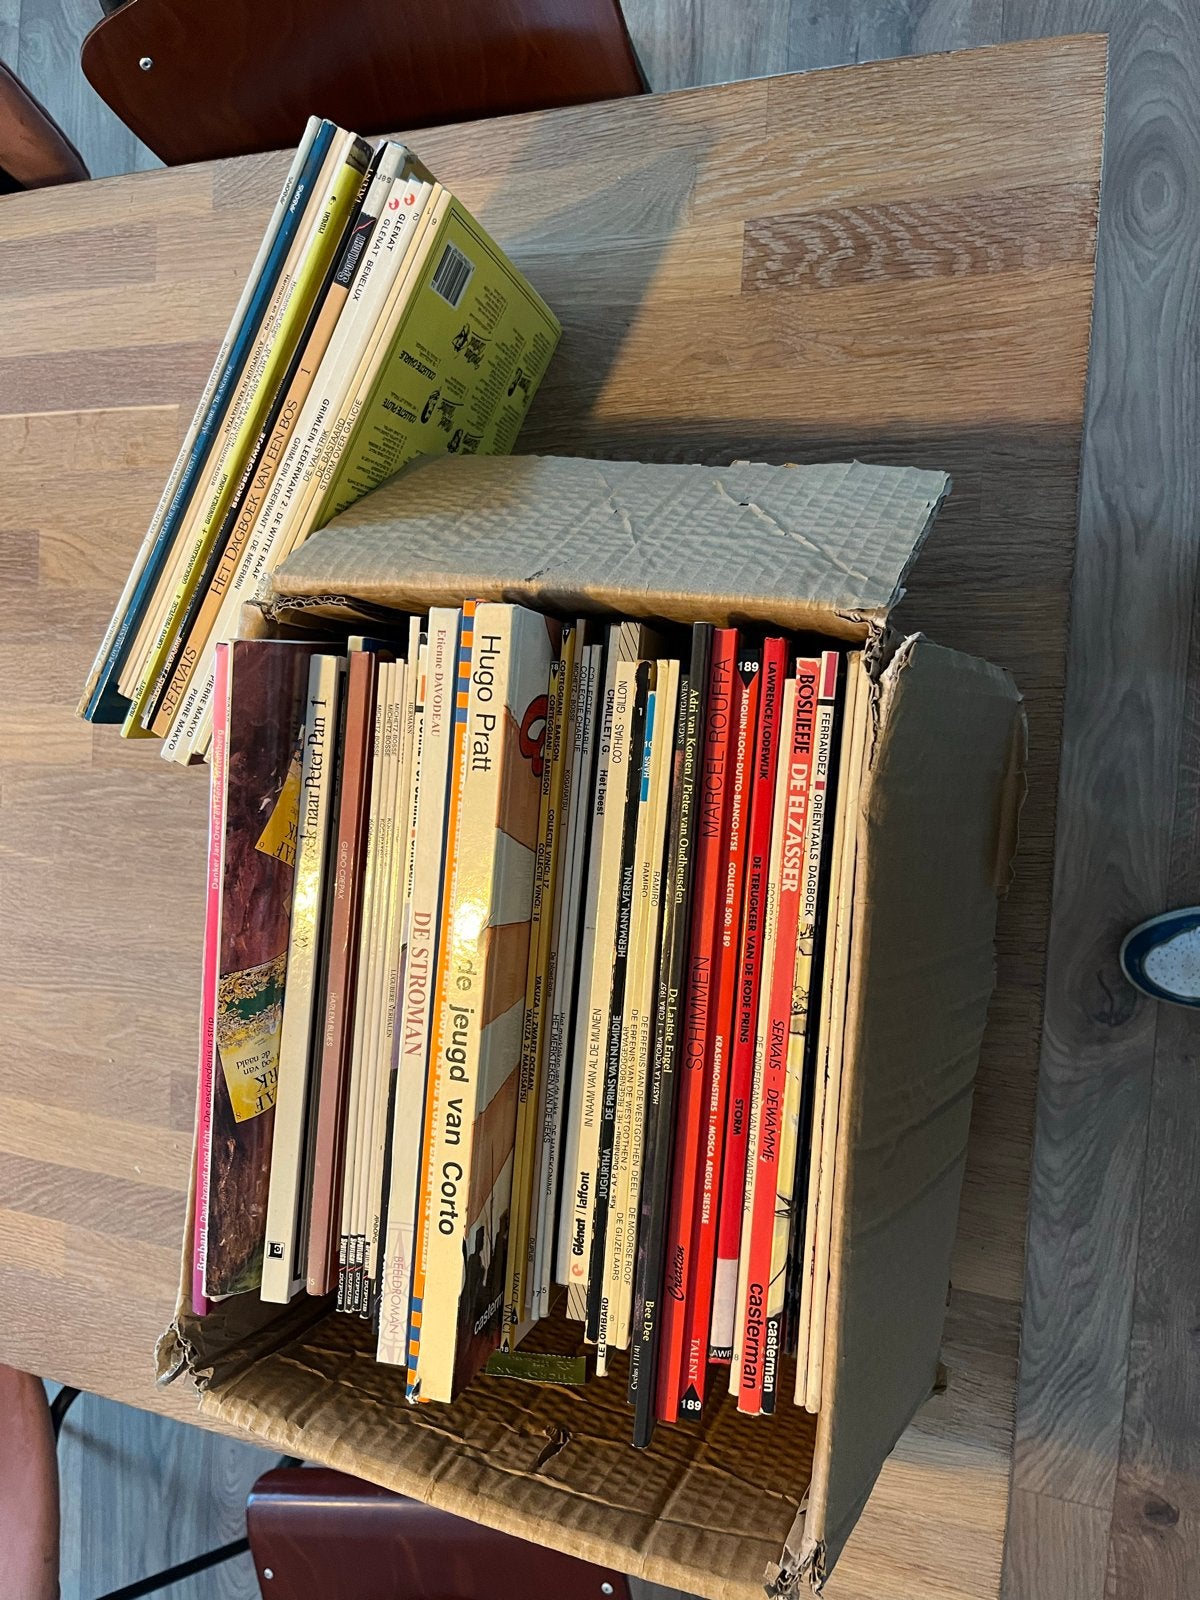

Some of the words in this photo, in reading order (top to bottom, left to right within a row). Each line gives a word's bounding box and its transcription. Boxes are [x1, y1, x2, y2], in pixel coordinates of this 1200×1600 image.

[317, 211, 331, 233] PANDA
[306, 398, 330, 442] GRIMLEIN
[253, 462, 273, 491] VAN
[265, 431, 285, 460] EEN
[278, 398, 299, 429] BOS
[302, 469, 312, 481] DE
[307, 429, 329, 468] VALSTRIK
[314, 465, 325, 477] DE
[321, 417, 345, 463] BASTAARD
[318, 460, 336, 490] STORM
[332, 435, 347, 459] OVER
[342, 399, 362, 433] GALICIE
[283, 444, 311, 499] LEDERWANT
[273, 511, 283, 524] DE
[260, 526, 277, 555] WITTE
[250, 555, 265, 579] RAAF
[435, 629, 445, 668] Etienne
[160, 645, 198, 716] SERVAIS
[471, 634, 501, 702] Hugo
[738, 661, 759, 672] 189
[181, 688, 198, 717] PIERRE
[199, 674, 216, 704] PIERRE
[556, 659, 566, 715] CORTEGGIANI
[576, 665, 587, 713] COLLECTIE
[616, 679, 627, 713] GILLON
[679, 679, 688, 720] UITGAVEN
[688, 689, 698, 712] Adri
[709, 657, 731, 744] ROUFFA
[431, 672, 443, 737] DAVODEAU
[602, 688, 615, 742] CHAILLET,
[759, 661, 776, 779] LAWRENCE/LODEWIJK
[793, 674, 815, 754] BOSLIEFJE
[167, 718, 185, 750] MAKYO
[185, 705, 203, 737] MAKYO
[308, 715, 325, 747] Pan
[545, 694, 556, 750] CORTEGGIANI
[573, 715, 582, 752] CHARLIE
[687, 715, 695, 734] van
[213, 729, 224, 778] Wittenberg
[472, 712, 495, 772] Pratt
[552, 724, 561, 761] BARISON
[601, 744, 609, 756] G.
[612, 723, 623, 763] COTHIAS
[684, 737, 695, 773] Kooten
[817, 712, 830, 775] FERRANDEZ
[305, 749, 322, 789] Peter
[542, 758, 551, 795] BARISON
[598, 769, 607, 786] Het
[643, 755, 651, 778] HANS
[789, 763, 807, 791] DE
[213, 780, 222, 802] Henk
[596, 789, 605, 815] beest
[681, 784, 691, 814] Pieter
[702, 749, 724, 837] MARCEL
[213, 804, 221, 816] en
[306, 790, 320, 827] naar
[680, 817, 688, 835] van
[808, 794, 823, 860] ORIËNTAALS
[211, 842, 220, 856] Jan
[339, 841, 347, 866] GUIDO
[781, 795, 805, 892] ELZASSER
[210, 858, 219, 889] Danker
[535, 843, 544, 880] COLLECTIE
[675, 837, 688, 904] Oudheusden
[752, 856, 761, 868] DE
[337, 869, 346, 899] CREPAX
[641, 861, 649, 897] RAMIRO
[650, 870, 660, 906] RAMIRO
[725, 862, 735, 904] COLLECTIE
[804, 865, 816, 916] DAGBOEK
[533, 884, 541, 908] VINCI:
[748, 873, 759, 930] TERUGKEER
[412, 911, 431, 939] DE
[532, 912, 539, 921] 18
[723, 907, 732, 926] 500:
[722, 930, 730, 946] 189
[746, 935, 755, 959] VAN
[456, 959, 477, 992] de
[744, 963, 753, 975] DE
[388, 969, 396, 1002] LUGUBERE
[404, 947, 428, 1055] STROMAN
[668, 988, 677, 1003] De
[742, 979, 752, 1008] RODE
[328, 992, 336, 1022] HARLEM
[685, 956, 709, 1070] SCHIMMEN
[326, 1024, 334, 1046] BLUES
[591, 1008, 600, 1041] MIJNEN
[610, 1014, 620, 1055] NUMIDIE
[665, 1006, 676, 1041] Laatste
[740, 1011, 750, 1043] PRINS
[444, 1004, 474, 1082] jeugd
[590, 1043, 598, 1056] DE
[756, 1036, 763, 1048] DE
[768, 1019, 784, 1069] SERVAIS
[589, 1057, 597, 1069] AL
[608, 1057, 617, 1077] VAN
[661, 1044, 673, 1073] Engel
[588, 1070, 596, 1088] VAN
[606, 1078, 615, 1105] PRINS
[751, 1051, 762, 1109] ONDERGANG
[585, 1090, 594, 1116] NAAM
[605, 1107, 613, 1119] DE
[708, 1114, 716, 1122] 1:
[732, 1098, 743, 1135] STORM
[444, 1096, 464, 1145] van
[585, 1117, 592, 1127] IN
[749, 1113, 757, 1130] VAN
[761, 1088, 779, 1161] DEWAMME
[706, 1125, 716, 1157] MOSCA
[748, 1133, 756, 1146] DE
[599, 1146, 610, 1199] JUGURTHA
[703, 1159, 713, 1190] ARGUS
[745, 1149, 754, 1186] ZWARTE
[437, 1160, 462, 1236] Corto
[628, 1207, 635, 1218] DE
[701, 1192, 710, 1224] SIESTAE
[743, 1189, 751, 1211] VALK
[616, 1212, 623, 1224] DE
[612, 1227, 622, 1280] GIJZELAARS
[625, 1220, 634, 1258] MOORSE
[623, 1260, 631, 1285] ROOF
[668, 1244, 688, 1301] Création
[388, 1256, 403, 1333] BEELDROMAN
[644, 1300, 654, 1318] Bee
[503, 1304, 512, 1333] VINCI
[599, 1297, 608, 1344] LOMBARD
[642, 1321, 651, 1341] Dee
[598, 1347, 605, 1357] LE
[742, 1283, 764, 1389] casterman
[688, 1337, 699, 1381] TALENT
[763, 1320, 779, 1392] casterman
[681, 1399, 701, 1410] 189
